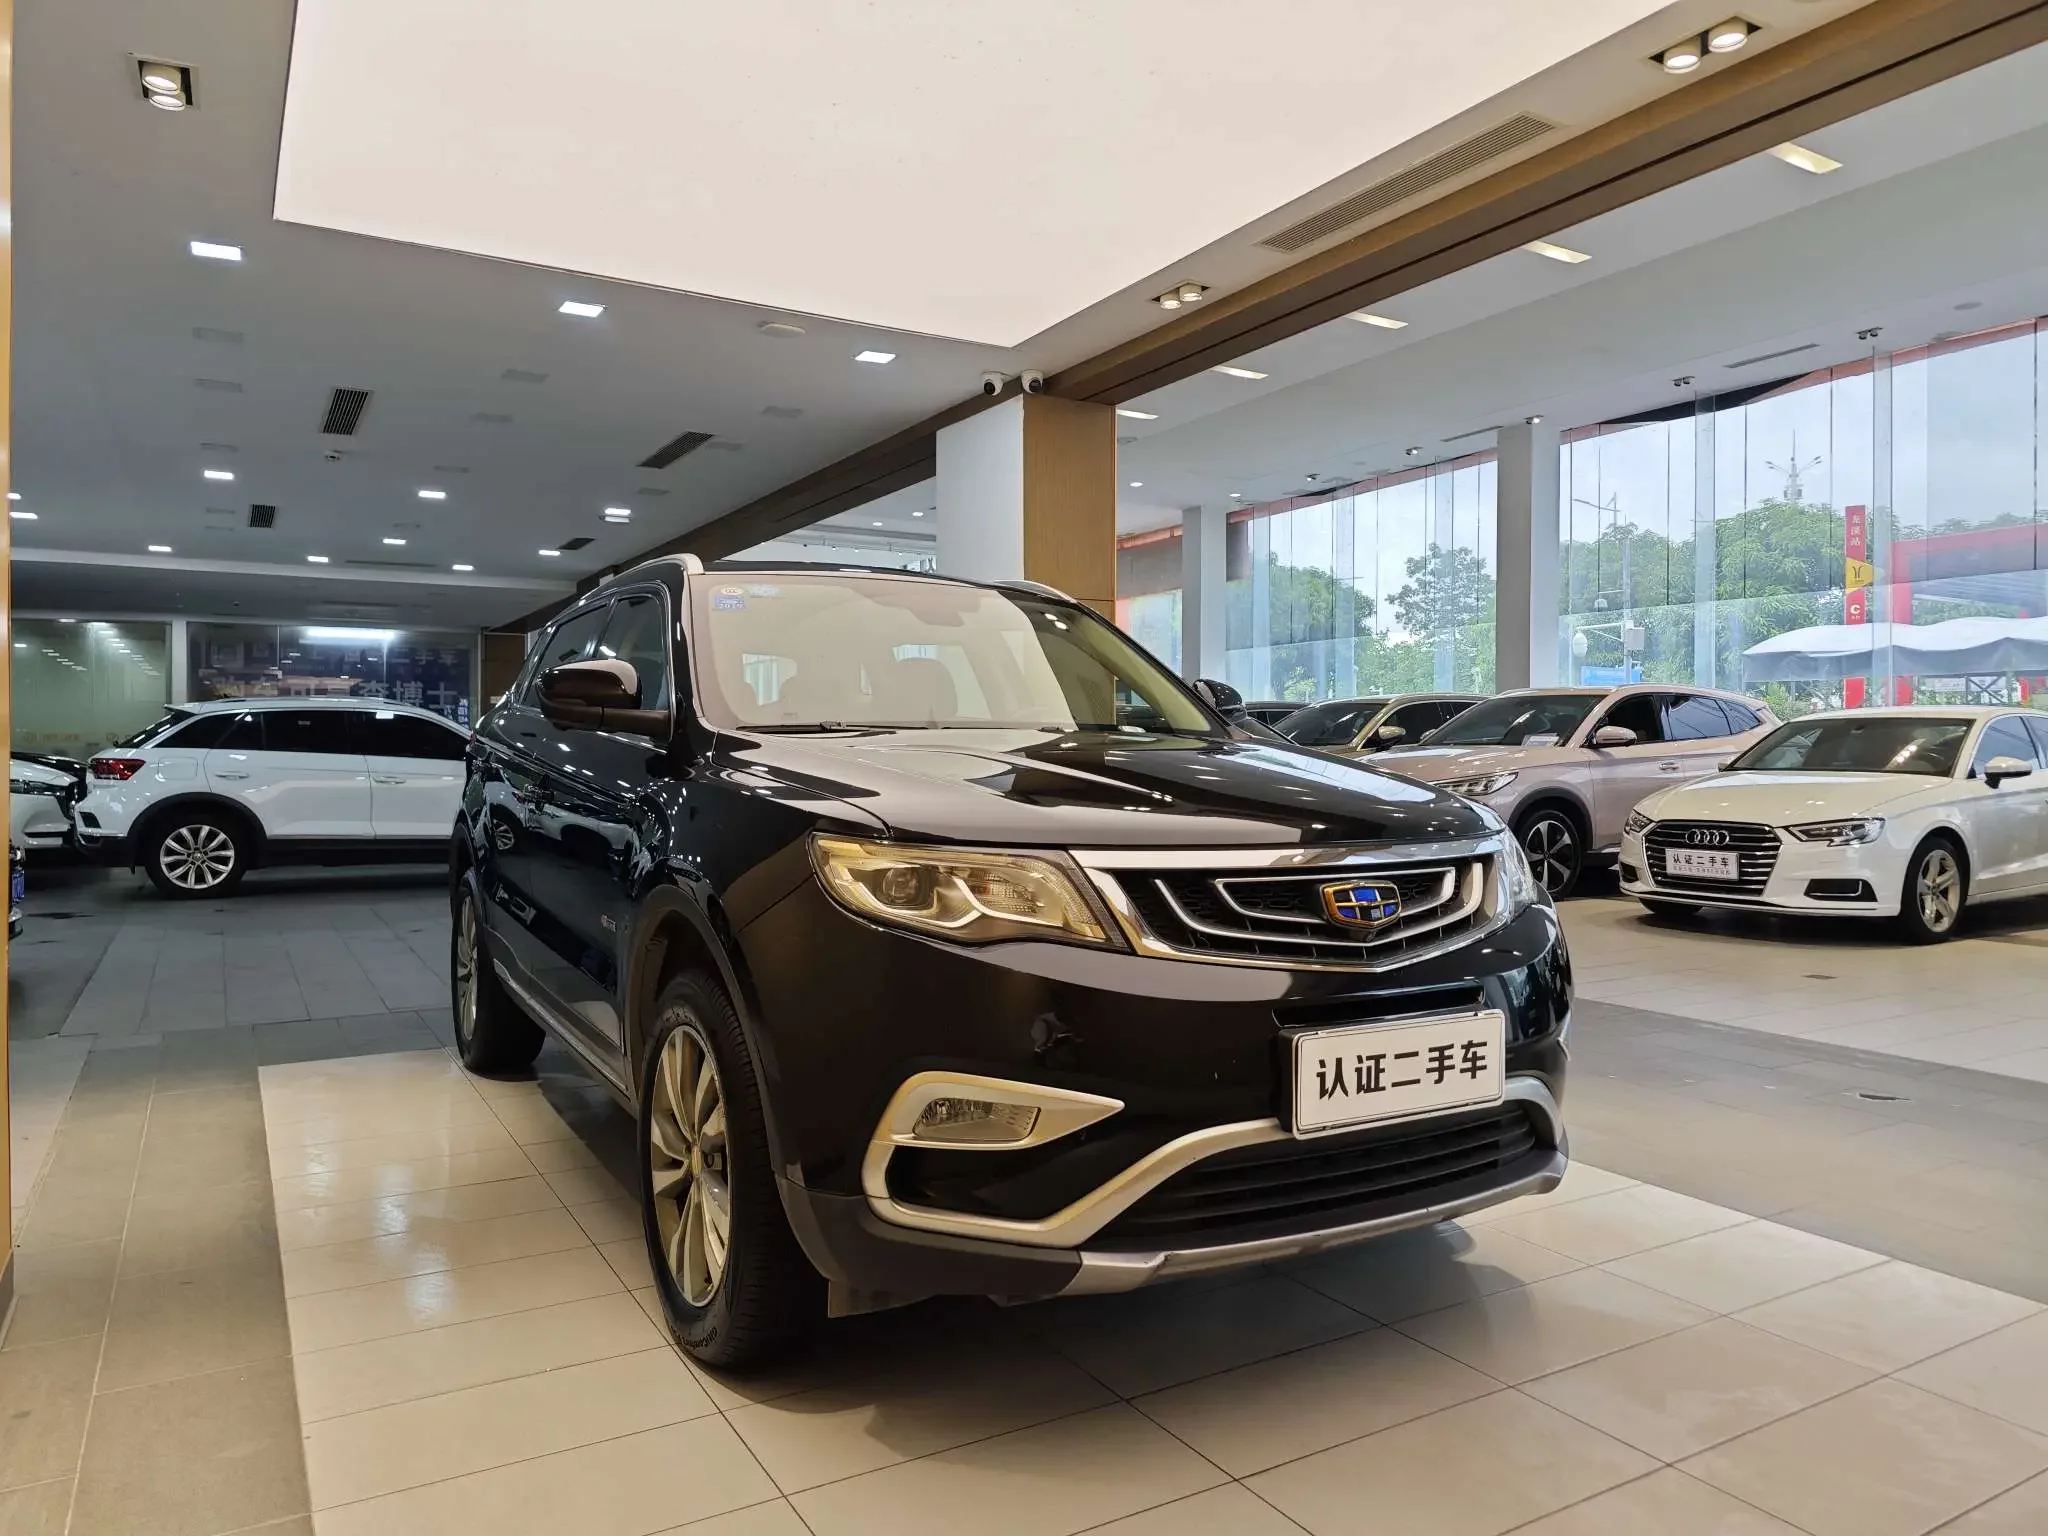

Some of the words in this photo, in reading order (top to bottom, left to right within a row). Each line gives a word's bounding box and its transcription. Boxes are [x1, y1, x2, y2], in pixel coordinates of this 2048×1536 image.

[1673, 852, 1729, 868] 认证二手车
[1316, 1039, 1488, 1101] 认证二手车
